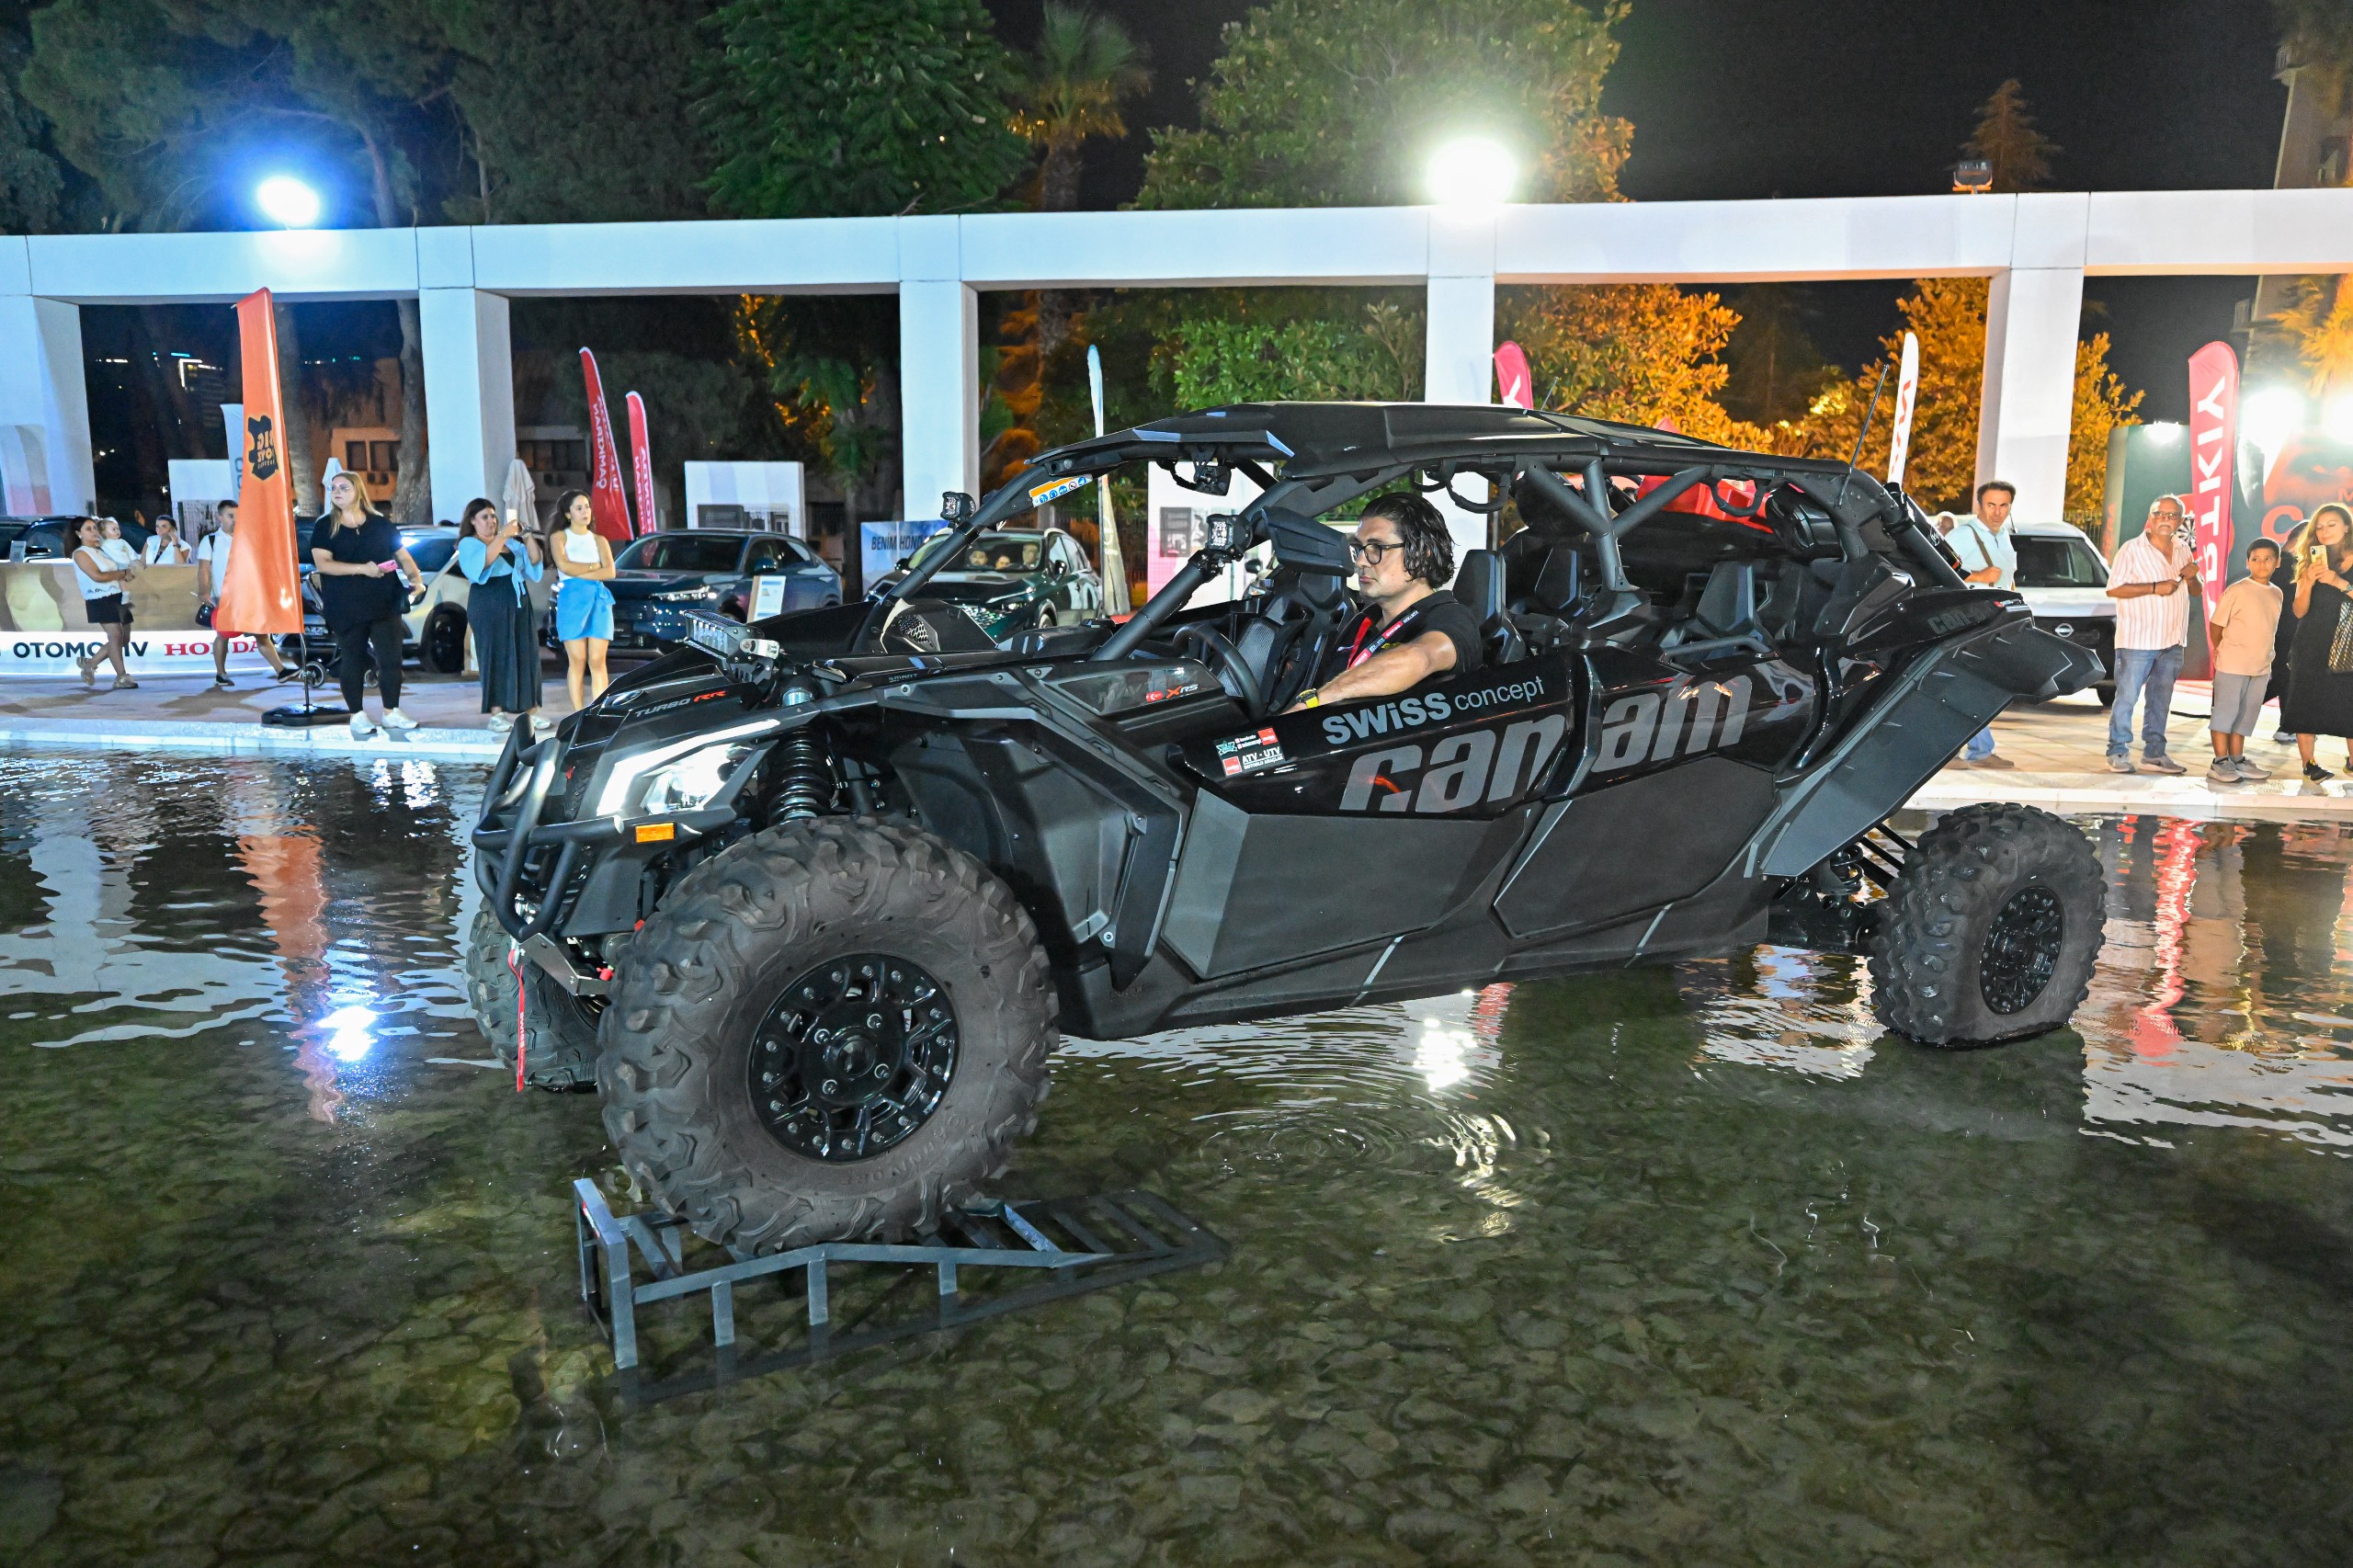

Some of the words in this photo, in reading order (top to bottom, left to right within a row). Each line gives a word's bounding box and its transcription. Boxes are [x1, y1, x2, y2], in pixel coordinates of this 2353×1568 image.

[899, 536, 925, 551] HOND
[13, 641, 149, 658] OTOMOIV
[163, 641, 259, 656] HODA
[1454, 676, 1544, 710] concept
[635, 698, 691, 717] TURBO
[693, 690, 726, 702] RR
[1242, 753, 1256, 764] ATV
[1263, 746, 1280, 757] UTV
